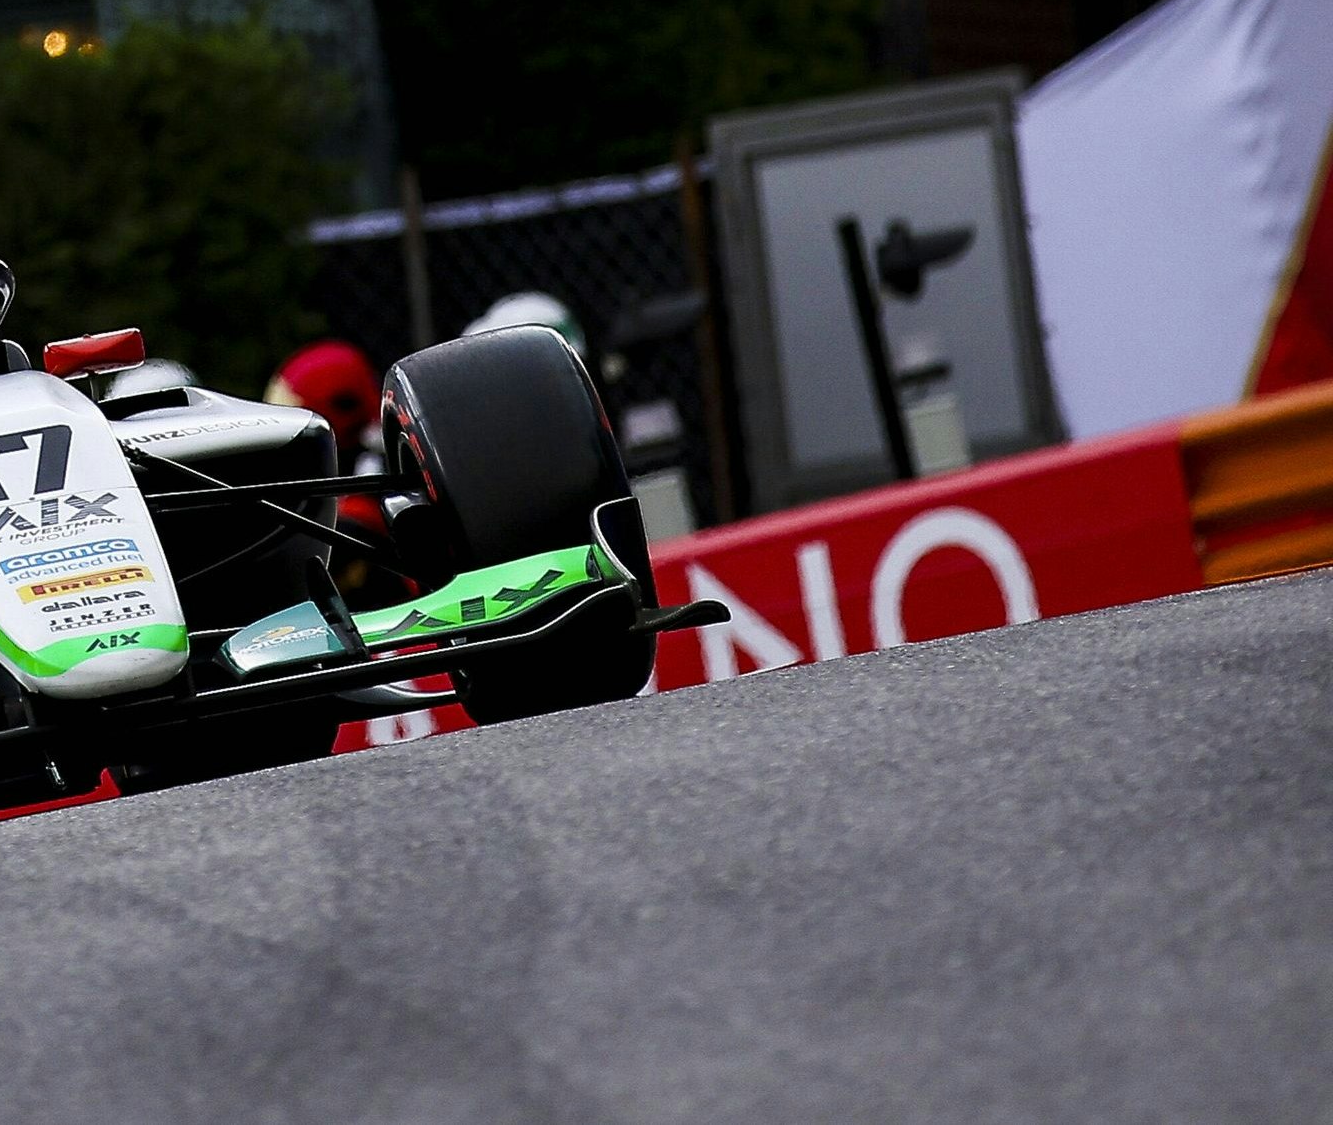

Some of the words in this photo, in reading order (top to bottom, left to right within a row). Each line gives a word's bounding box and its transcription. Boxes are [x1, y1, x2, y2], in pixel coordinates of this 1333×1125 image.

[9, 517, 125, 540] INVESTMENT
[20, 528, 86, 546] GROUP
[6, 539, 132, 569] aramco
[8, 557, 103, 584] advanced
[109, 552, 144, 563] fuel
[31, 568, 145, 596] PIRELLI
[41, 590, 146, 613] dallara
[49, 603, 152, 626] JENZER
[85, 631, 140, 652] AIX
